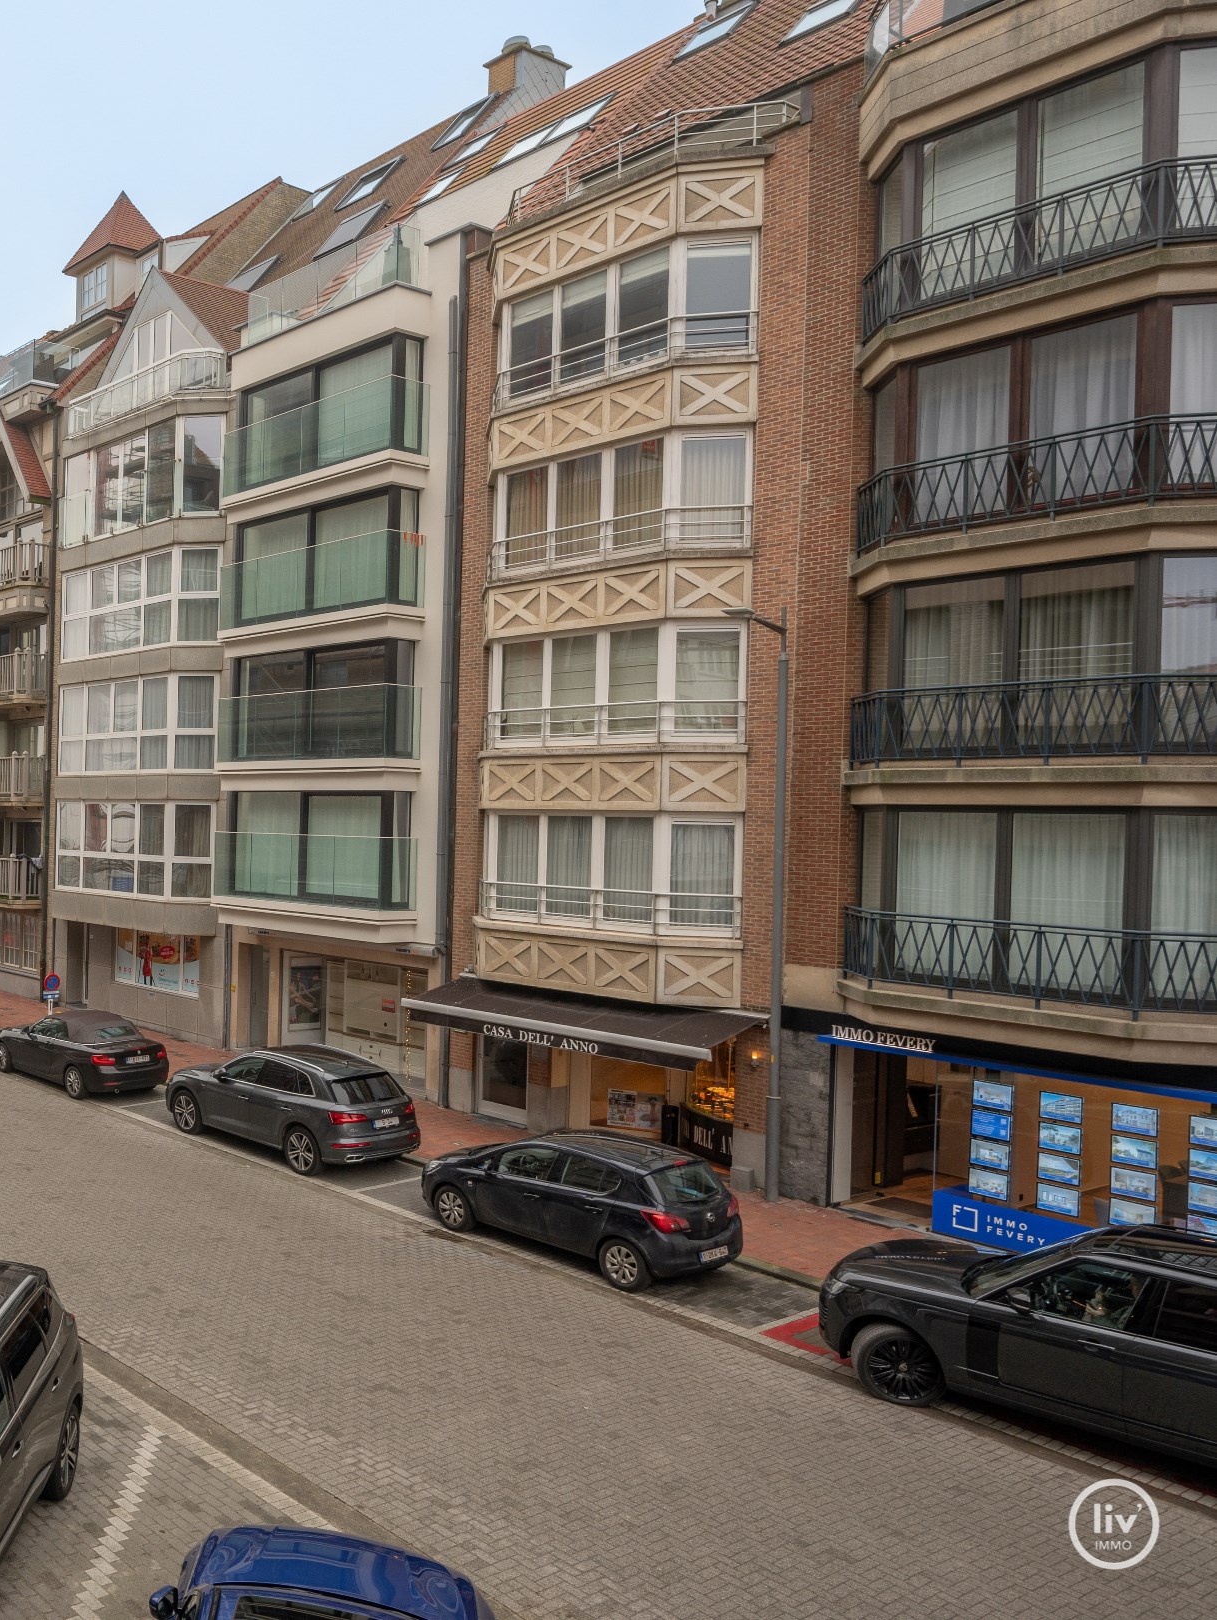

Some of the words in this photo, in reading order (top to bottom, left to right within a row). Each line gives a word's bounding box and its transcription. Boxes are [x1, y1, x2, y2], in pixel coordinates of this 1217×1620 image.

[483, 1024, 513, 1038] CASA
[519, 1030, 554, 1046] DELL'
[560, 1039, 598, 1054] ANNO
[832, 1025, 873, 1042] IMMO
[876, 1032, 937, 1052] FEVERY
[987, 1215, 1028, 1231] IMMO
[986, 1226, 1045, 1245] FEVERY
